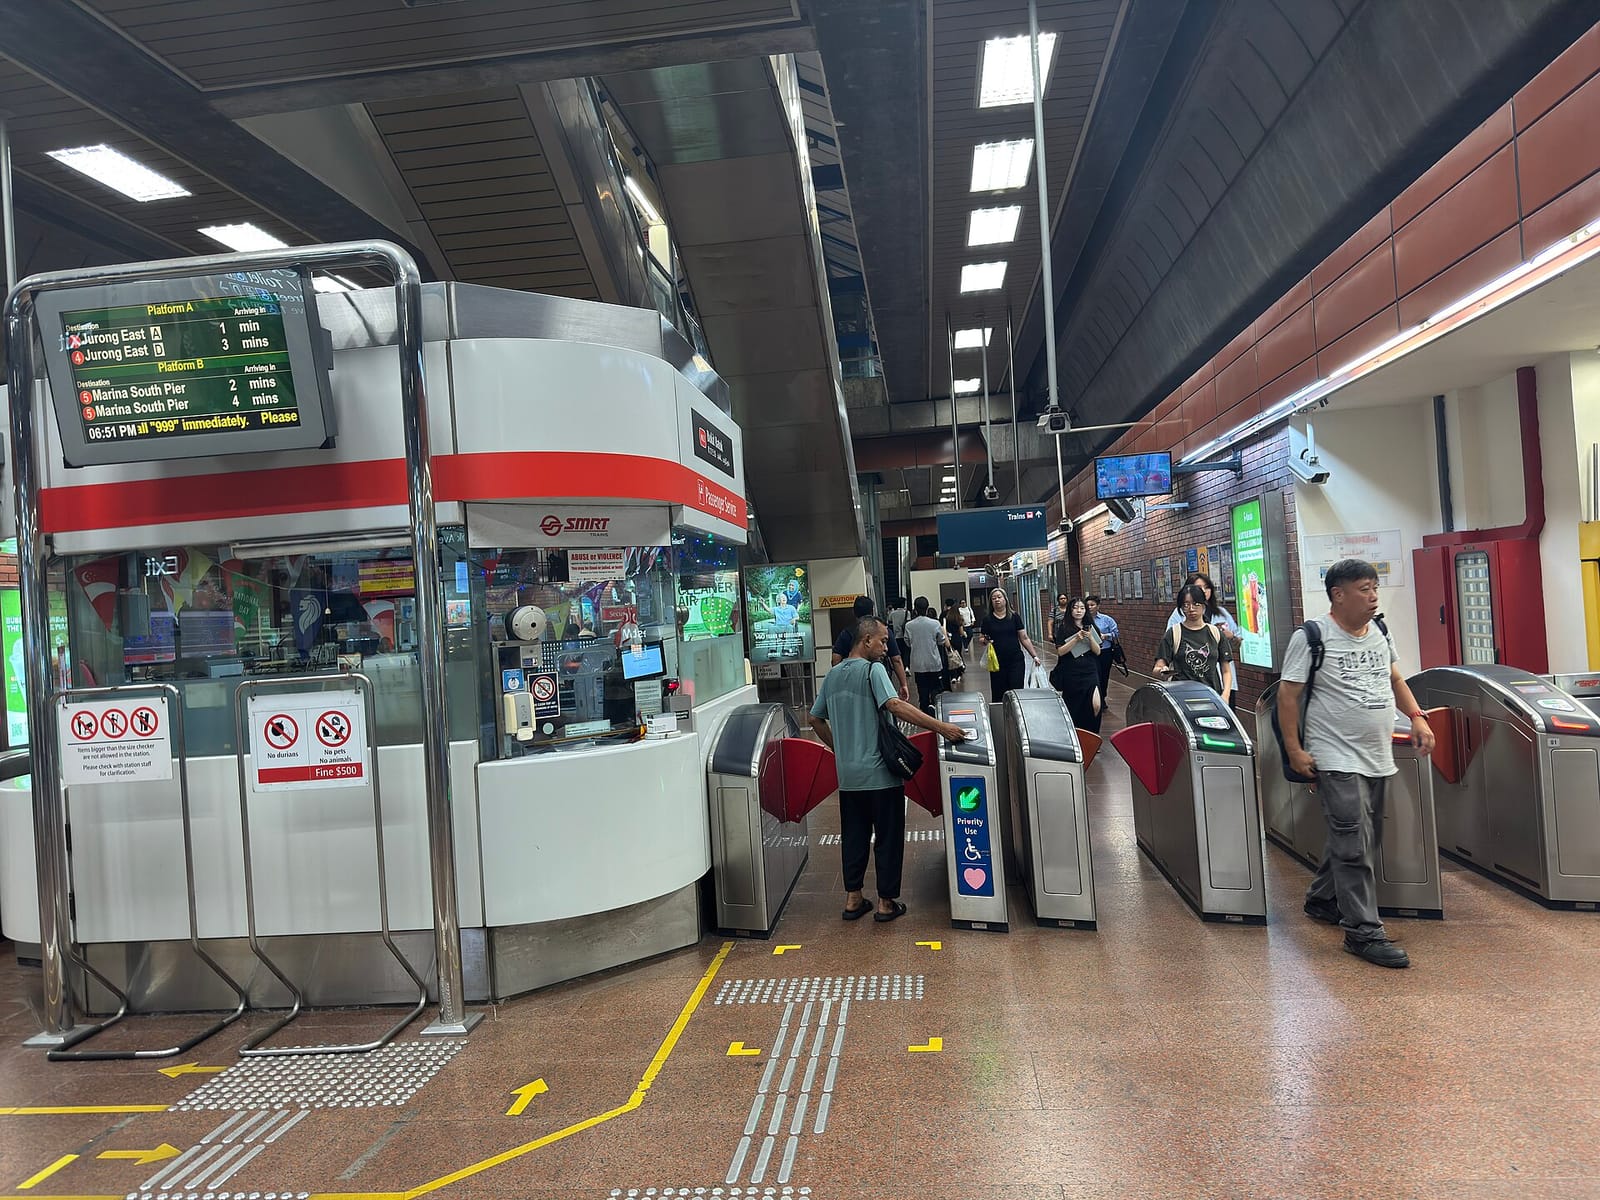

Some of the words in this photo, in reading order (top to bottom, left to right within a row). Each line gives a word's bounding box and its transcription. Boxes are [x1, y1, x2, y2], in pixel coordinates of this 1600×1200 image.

[147, 304, 185, 315] Platform
[186, 302, 194, 312] A
[234, 307, 259, 316] Arriving
[65, 323, 99, 332] Destination
[81, 332, 120, 346] Jurong
[121, 328, 147, 342] East
[151, 327, 162, 340] A
[219, 322, 226, 334] 1
[239, 320, 260, 333] min
[75, 353, 81, 363] 4
[85, 348, 122, 362] Jurong
[123, 345, 149, 358] East
[154, 344, 164, 356] D
[222, 338, 229, 350] 3
[242, 336, 269, 349] mins
[158, 361, 195, 373] Platform
[196, 359, 205, 369] B
[244, 365, 269, 373] Arriving
[77, 379, 111, 389] Destination
[84, 393, 90, 403] 5
[92, 388, 128, 402] Marina
[131, 385, 162, 398] South
[164, 382, 186, 395] Pier
[229, 379, 237, 391] 2
[249, 377, 277, 390] mins
[86, 409, 93, 419] 5
[95, 405, 132, 418] Marina
[134, 401, 165, 414] South
[167, 399, 189, 411] Pier
[232, 395, 240, 407] 4
[252, 393, 279, 405] mins
[150, 419, 179, 433] "999"
[182, 413, 250, 431] immediately.
[261, 411, 298, 424] Please
[88, 425, 117, 440] 06:51
[119, 424, 137, 437] PM
[1007, 512, 1026, 521] Trains
[564, 517, 610, 530] SMRT
[597, 552, 623, 560] VIOLENCE
[679, 595, 697, 607] AIR
[100, 752, 118, 760] allowed
[276, 751, 299, 759] durians
[334, 748, 347, 756] pets
[328, 756, 353, 764] animals
[315, 767, 334, 777] Fine
[335, 766, 357, 777] $500
[957, 817, 984, 828] Priority
[964, 827, 978, 836] Use
